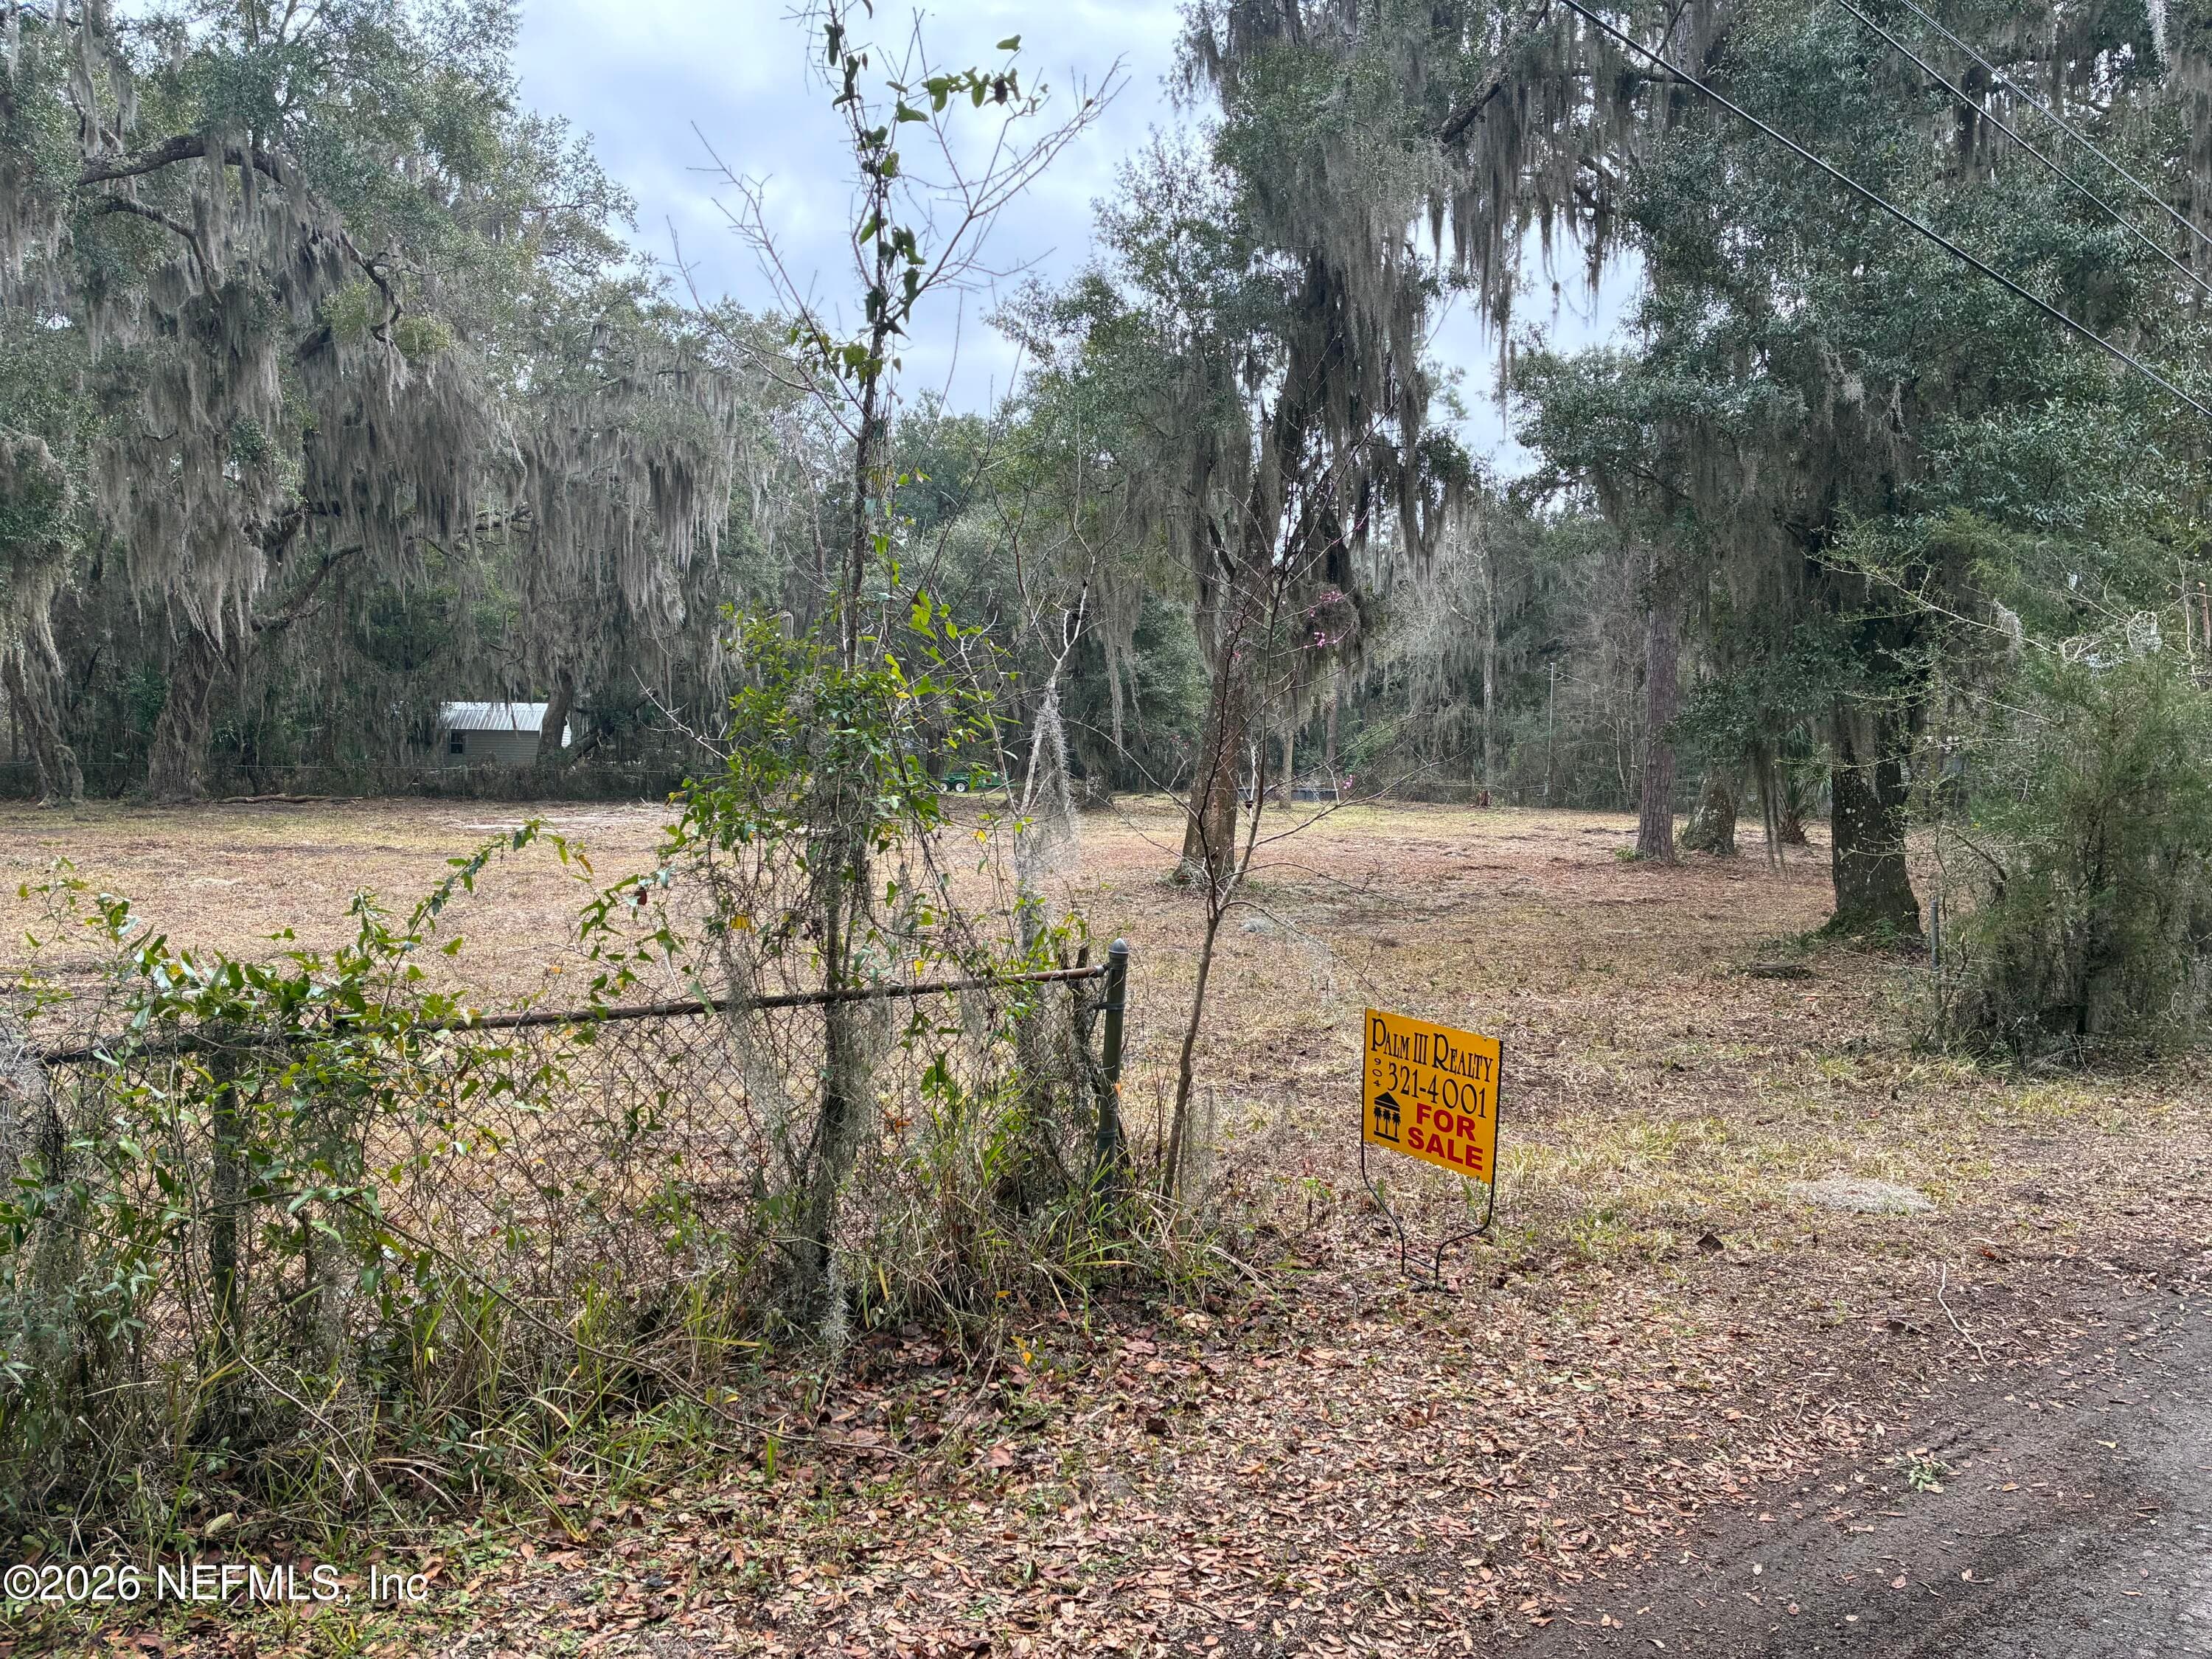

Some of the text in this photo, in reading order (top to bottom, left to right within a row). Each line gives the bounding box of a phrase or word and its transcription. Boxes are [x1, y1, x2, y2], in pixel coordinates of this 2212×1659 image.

[1388, 1061, 1486, 1119] 321-4001
[1416, 1102, 1476, 1141] FOR
[1407, 1127, 1484, 1171] SALE
